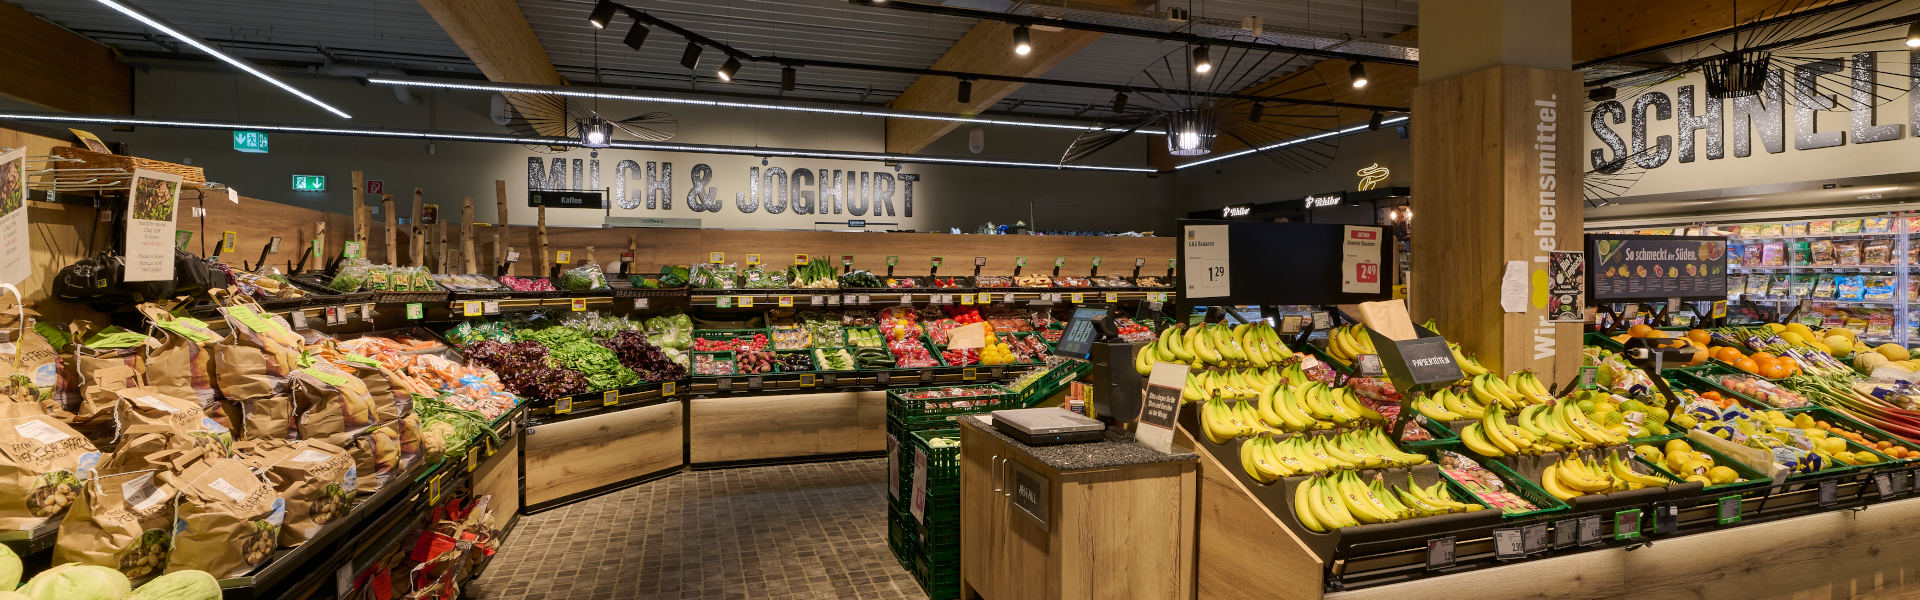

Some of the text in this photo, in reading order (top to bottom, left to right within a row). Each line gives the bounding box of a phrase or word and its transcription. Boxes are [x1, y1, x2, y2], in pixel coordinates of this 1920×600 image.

[1591, 51, 1920, 174] SCHNEL
[687, 163, 722, 213] &
[736, 166, 920, 218] JOGHURT
[1314, 196, 1340, 206] Tchibo
[1230, 208, 1250, 216] Tchibo
[1626, 248, 1634, 261] So
[1635, 248, 1668, 261] schmeckt
[1675, 247, 1697, 260] Süden.
[1019, 484, 1037, 504] ABFALL
